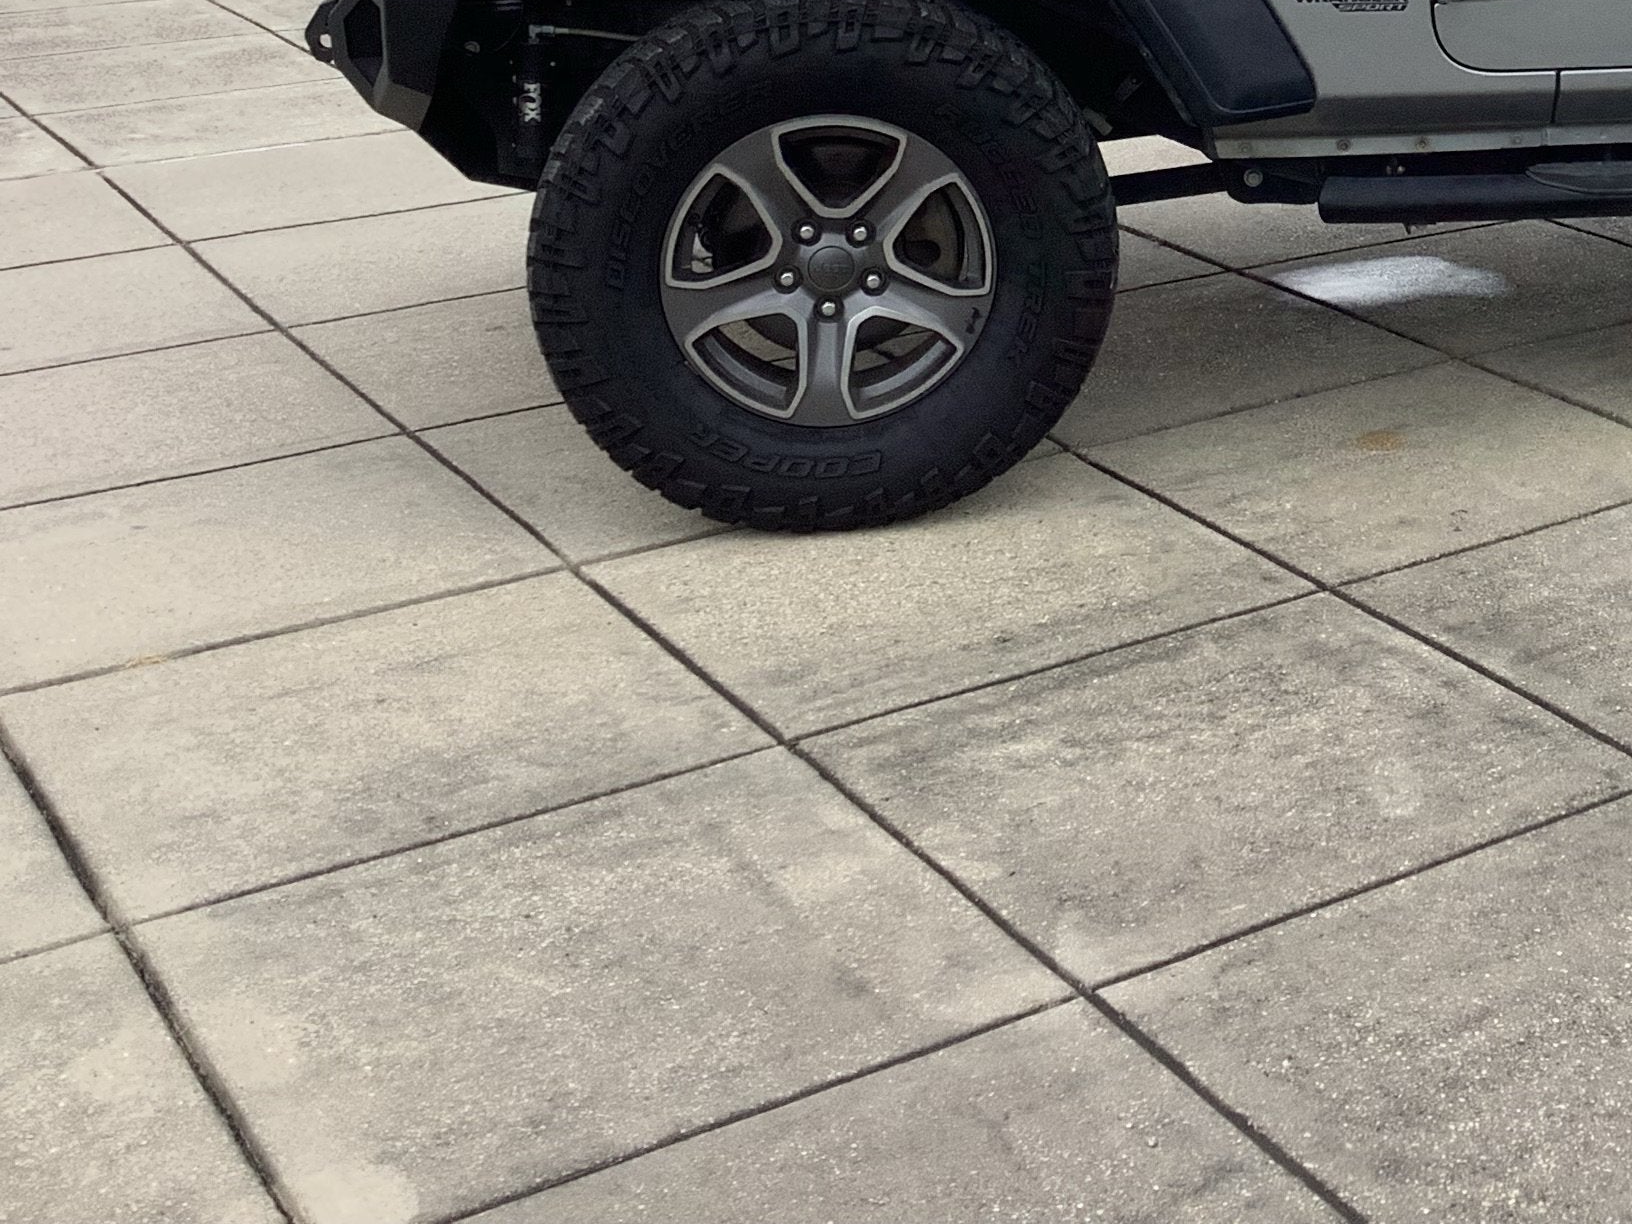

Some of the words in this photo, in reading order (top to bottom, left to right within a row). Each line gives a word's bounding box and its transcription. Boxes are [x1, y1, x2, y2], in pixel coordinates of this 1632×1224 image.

[1337, 3, 1407, 12] SPORT
[519, 82, 543, 124] FOX
[688, 424, 882, 480] COOPER
